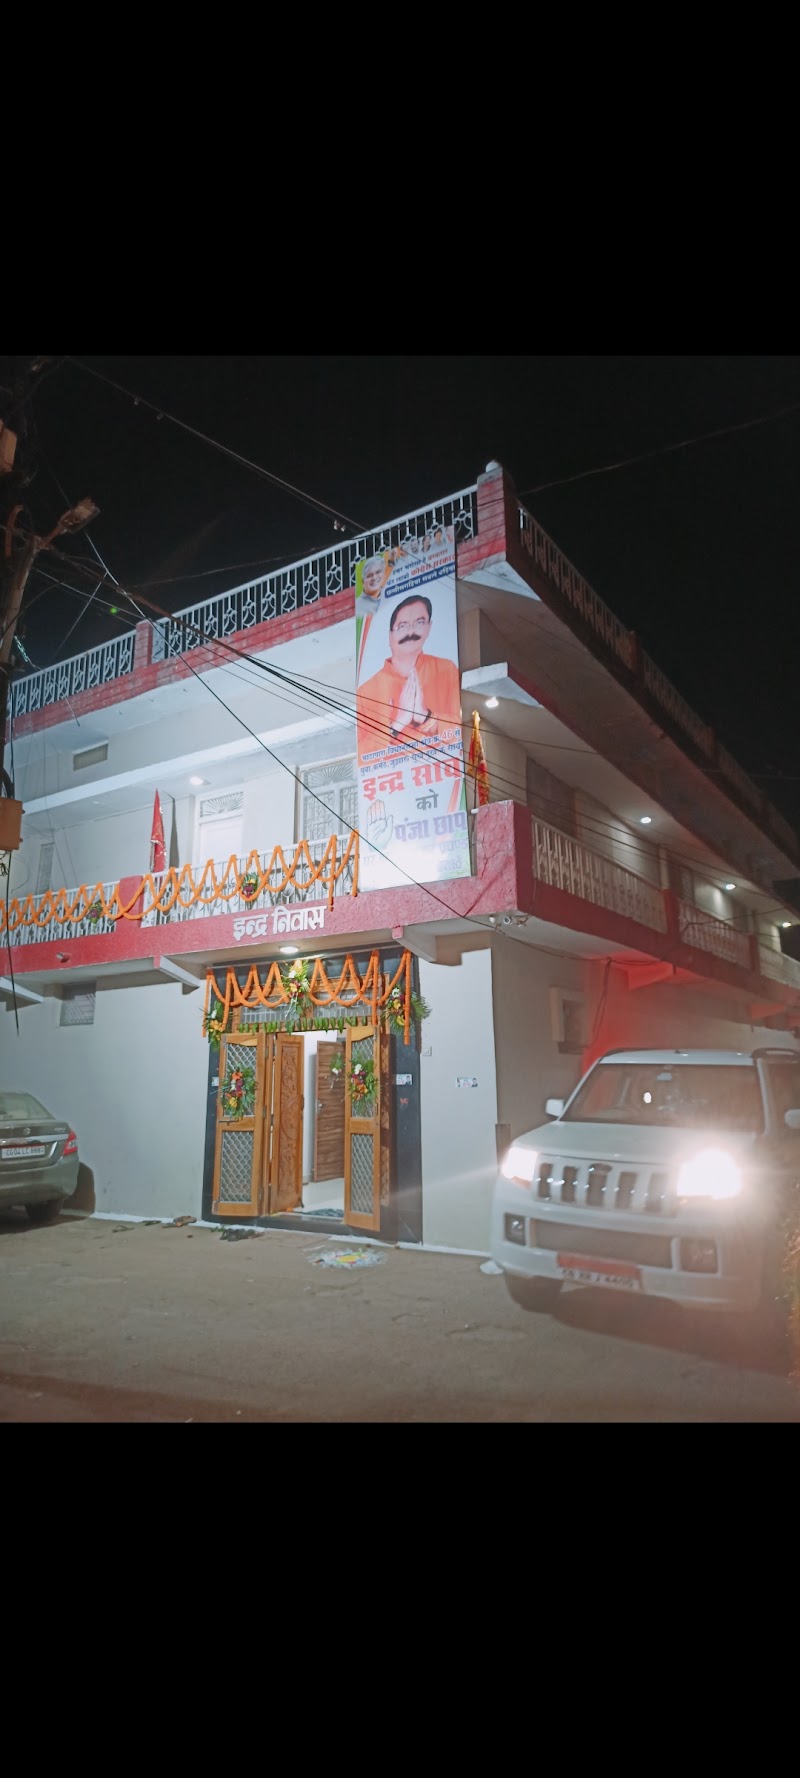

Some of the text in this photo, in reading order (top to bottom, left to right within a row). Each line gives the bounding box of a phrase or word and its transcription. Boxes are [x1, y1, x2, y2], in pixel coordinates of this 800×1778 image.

[362, 750, 386, 760] भाटापारा
[442, 730, 453, 740] 46
[437, 744, 445, 754] के
[447, 739, 463, 751] साथी
[362, 757, 462, 800] इन्द्र साव
[416, 789, 439, 811] को
[394, 812, 467, 842] पंजा छाप
[233, 906, 327, 941] इन्द्र निवास
